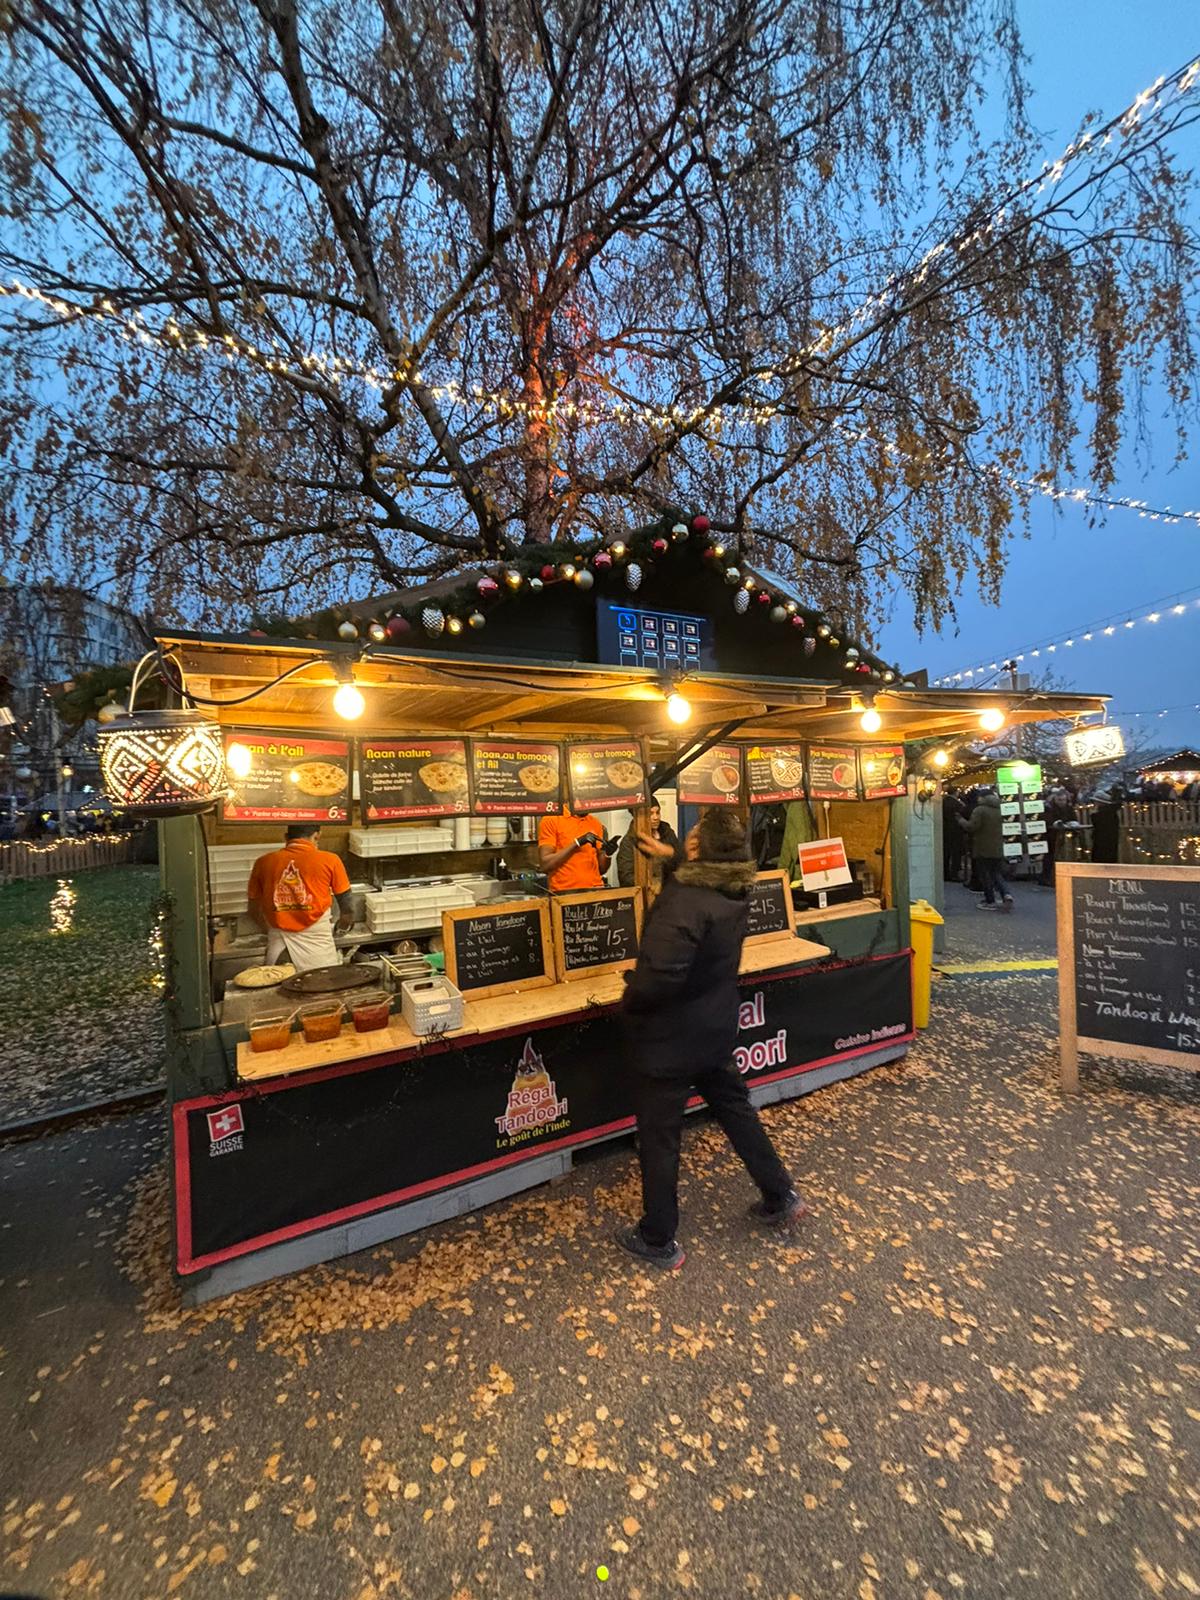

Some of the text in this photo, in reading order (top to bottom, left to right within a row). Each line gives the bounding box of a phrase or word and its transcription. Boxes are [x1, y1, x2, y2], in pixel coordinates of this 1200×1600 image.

[268, 744, 277, 755] à
[281, 745, 304, 756] l'ail
[366, 749, 431, 759] Naan nature
[476, 750, 500, 759] Naan
[516, 752, 552, 763] fromage
[605, 749, 636, 759] fromage
[328, 806, 347, 819] 6.-
[1109, 879, 1143, 894] MENU
[1094, 1001, 1164, 1023] Tandoori
[834, 1032, 870, 1050] Cuisine
[732, 1029, 787, 1074] oori
[508, 1081, 556, 1108] Régal
[495, 1098, 568, 1133] Tandoori
[210, 1135, 243, 1152] SUISSE
[496, 1138, 508, 1149] Le
[509, 1130, 531, 1147] goût
[532, 1127, 544, 1136] de
[209, 1143, 244, 1158] GARANTIE
